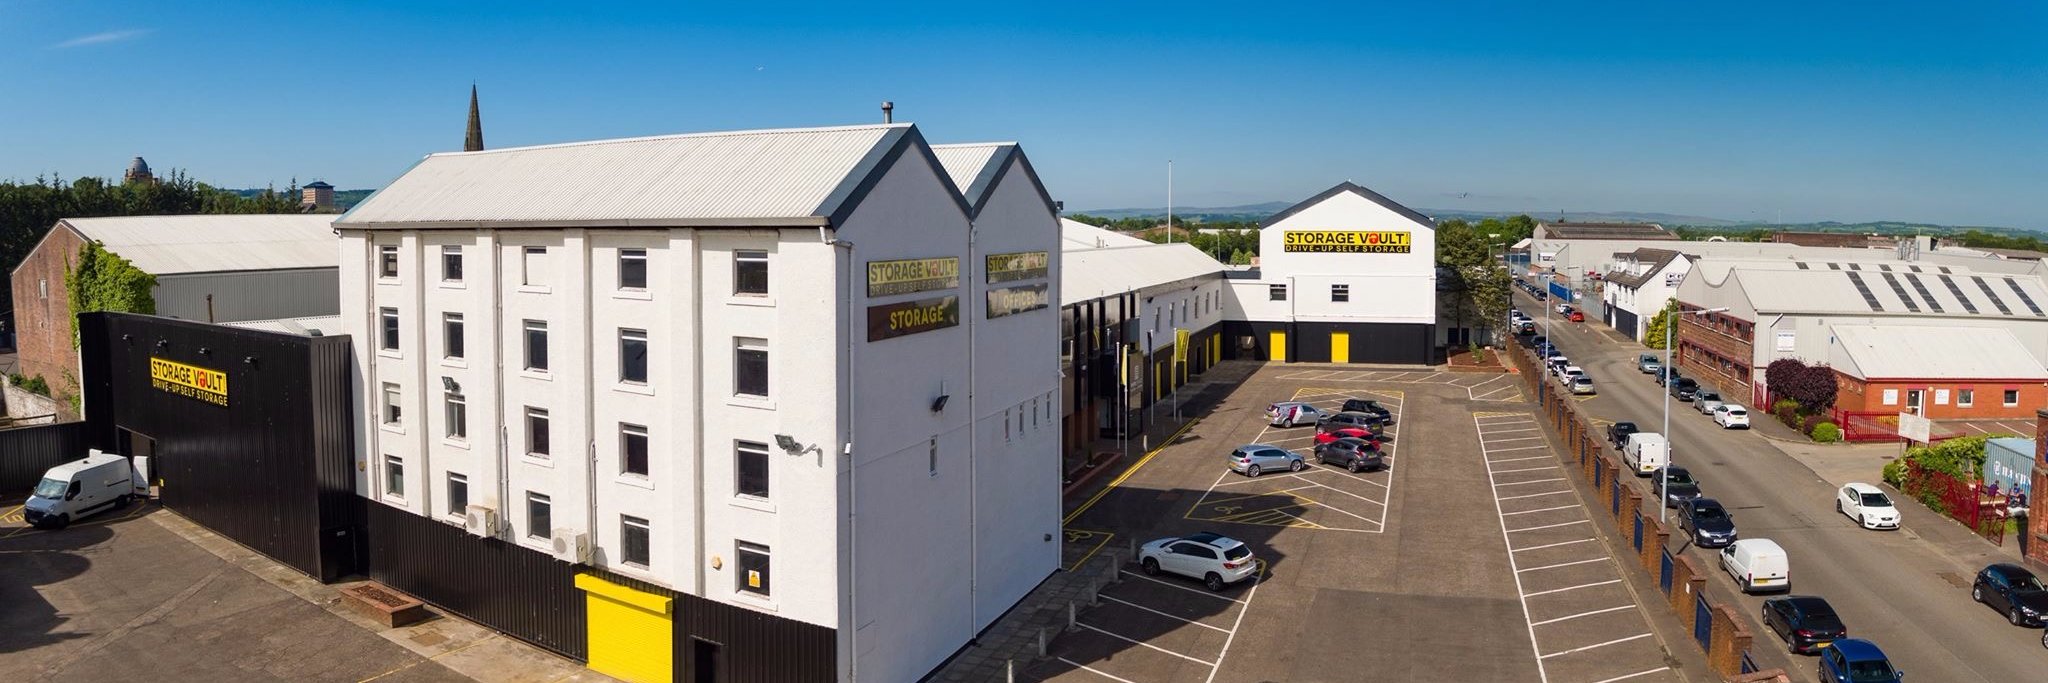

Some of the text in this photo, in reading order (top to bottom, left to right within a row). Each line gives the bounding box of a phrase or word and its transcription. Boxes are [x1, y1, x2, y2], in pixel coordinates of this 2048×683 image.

[1286, 232, 1355, 244] STORAGE
[870, 261, 923, 282] STORAGE
[988, 255, 1024, 271] STORE
[870, 281, 909, 296] DRIVE-UP
[1003, 292, 1036, 309] OFFICES
[890, 305, 944, 331] STORAGE
[152, 361, 191, 384] STORAGE
[152, 378, 228, 407] DRIVE-UP SELF STORAGE
